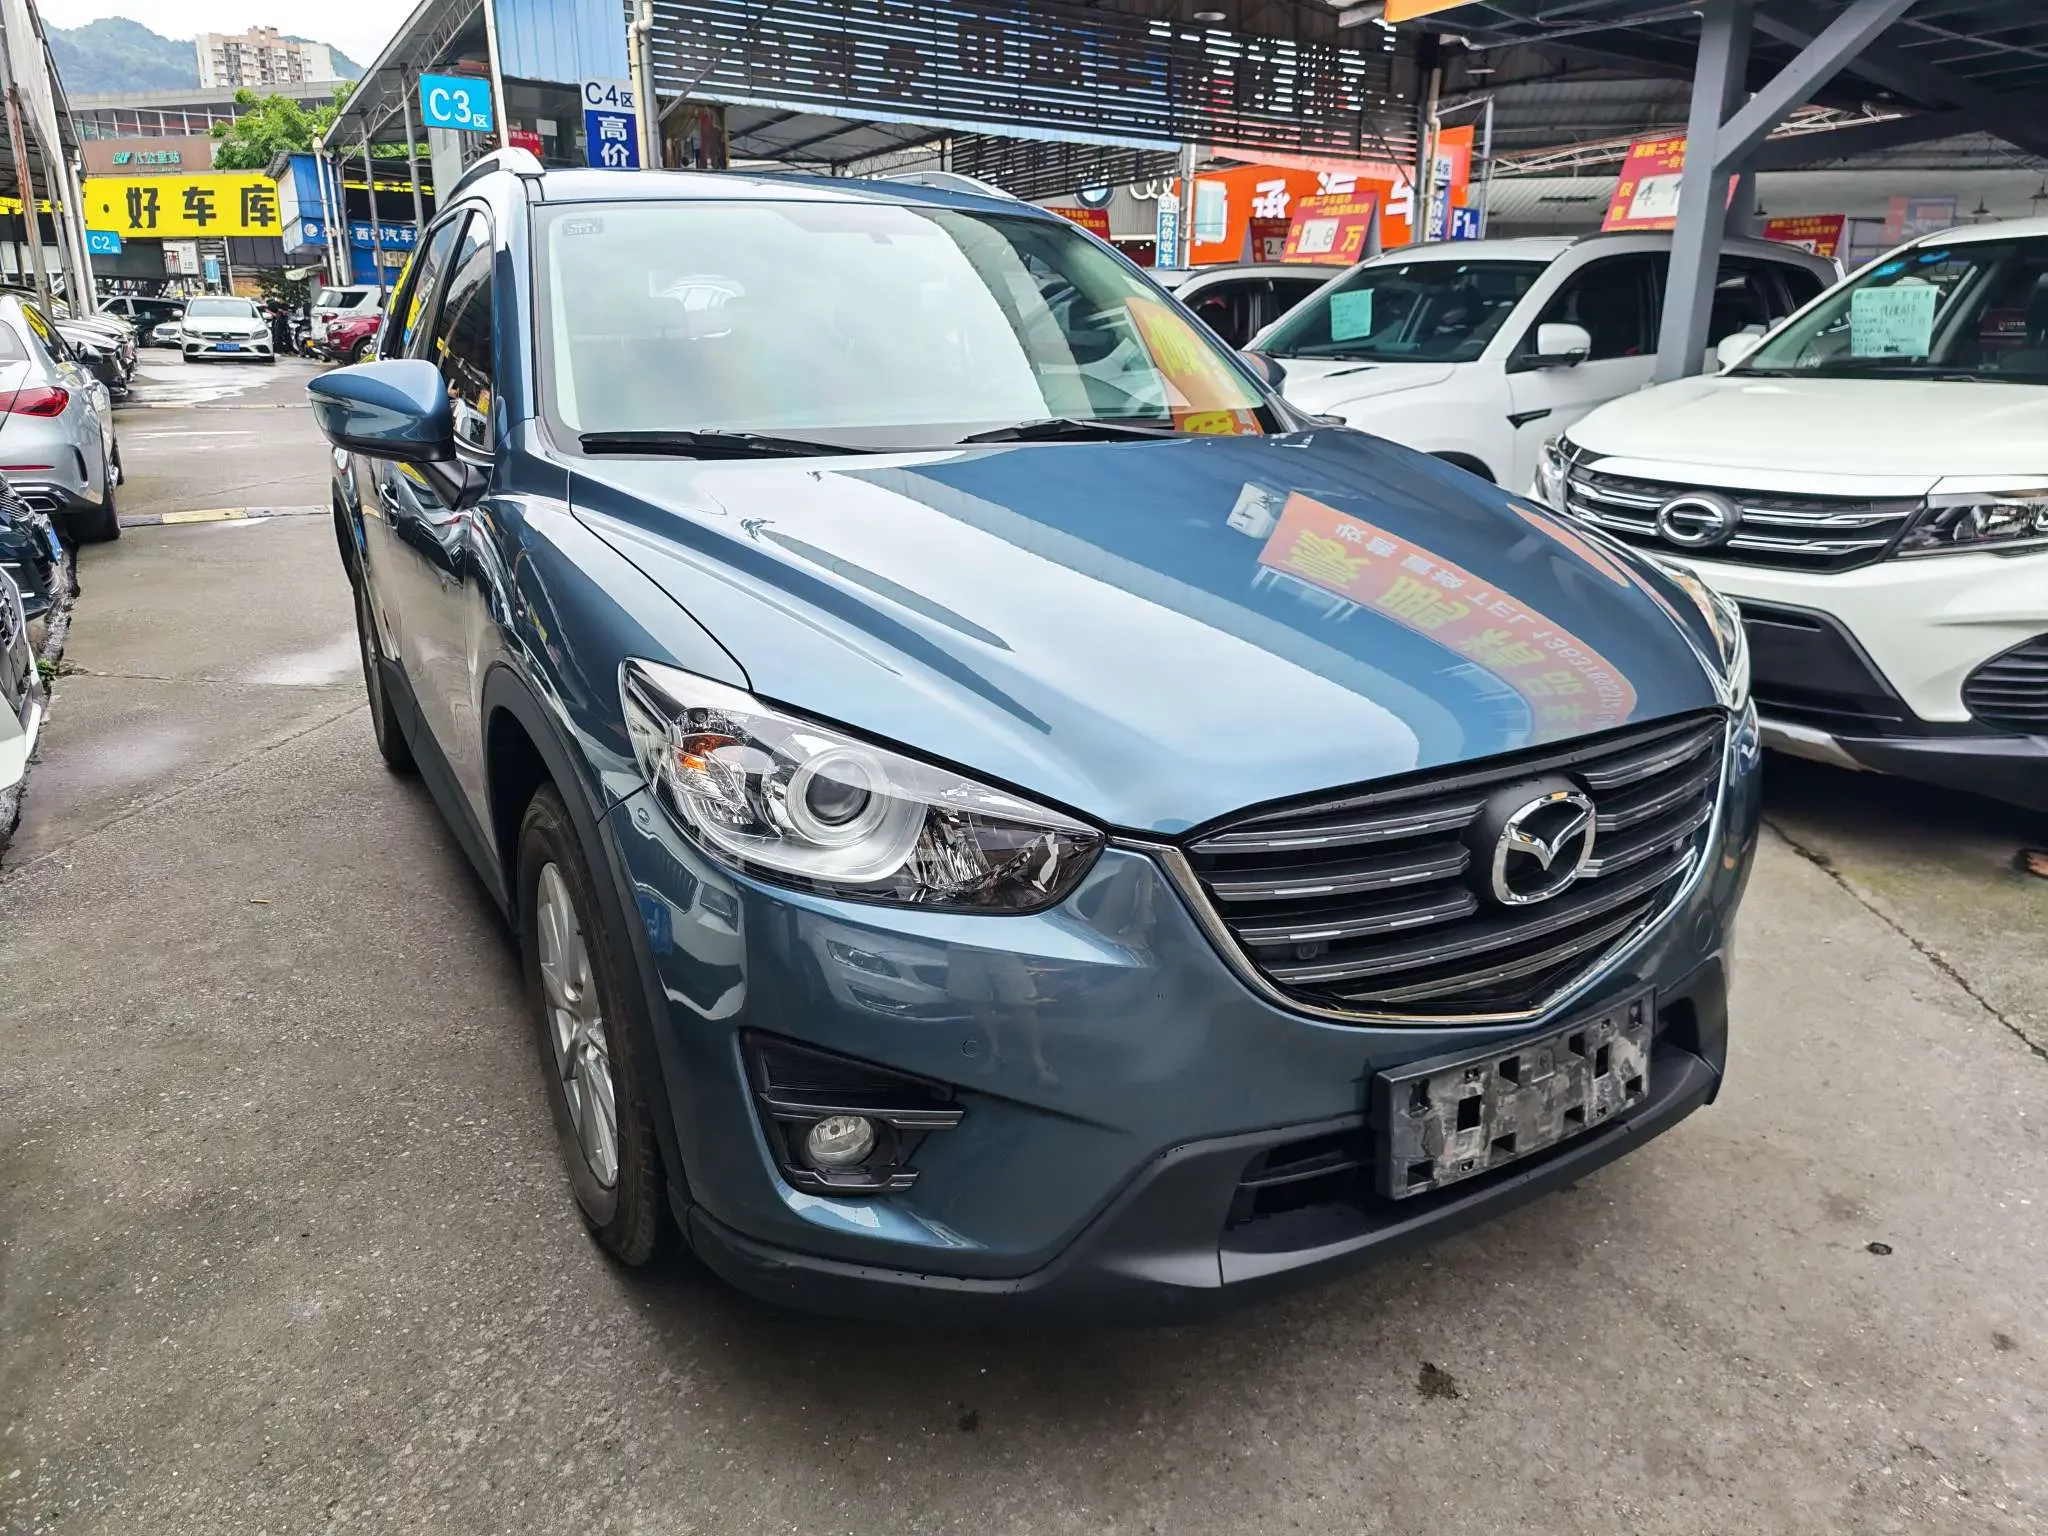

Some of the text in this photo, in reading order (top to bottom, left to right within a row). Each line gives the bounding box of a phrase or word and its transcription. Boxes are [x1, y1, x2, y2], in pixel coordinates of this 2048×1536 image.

[429, 87, 488, 128] C3区
[585, 82, 634, 108] C4区
[355, 226, 418, 242] 西部汽车
[1304, 227, 1336, 246] 1.8
[1340, 225, 1365, 252] 万
